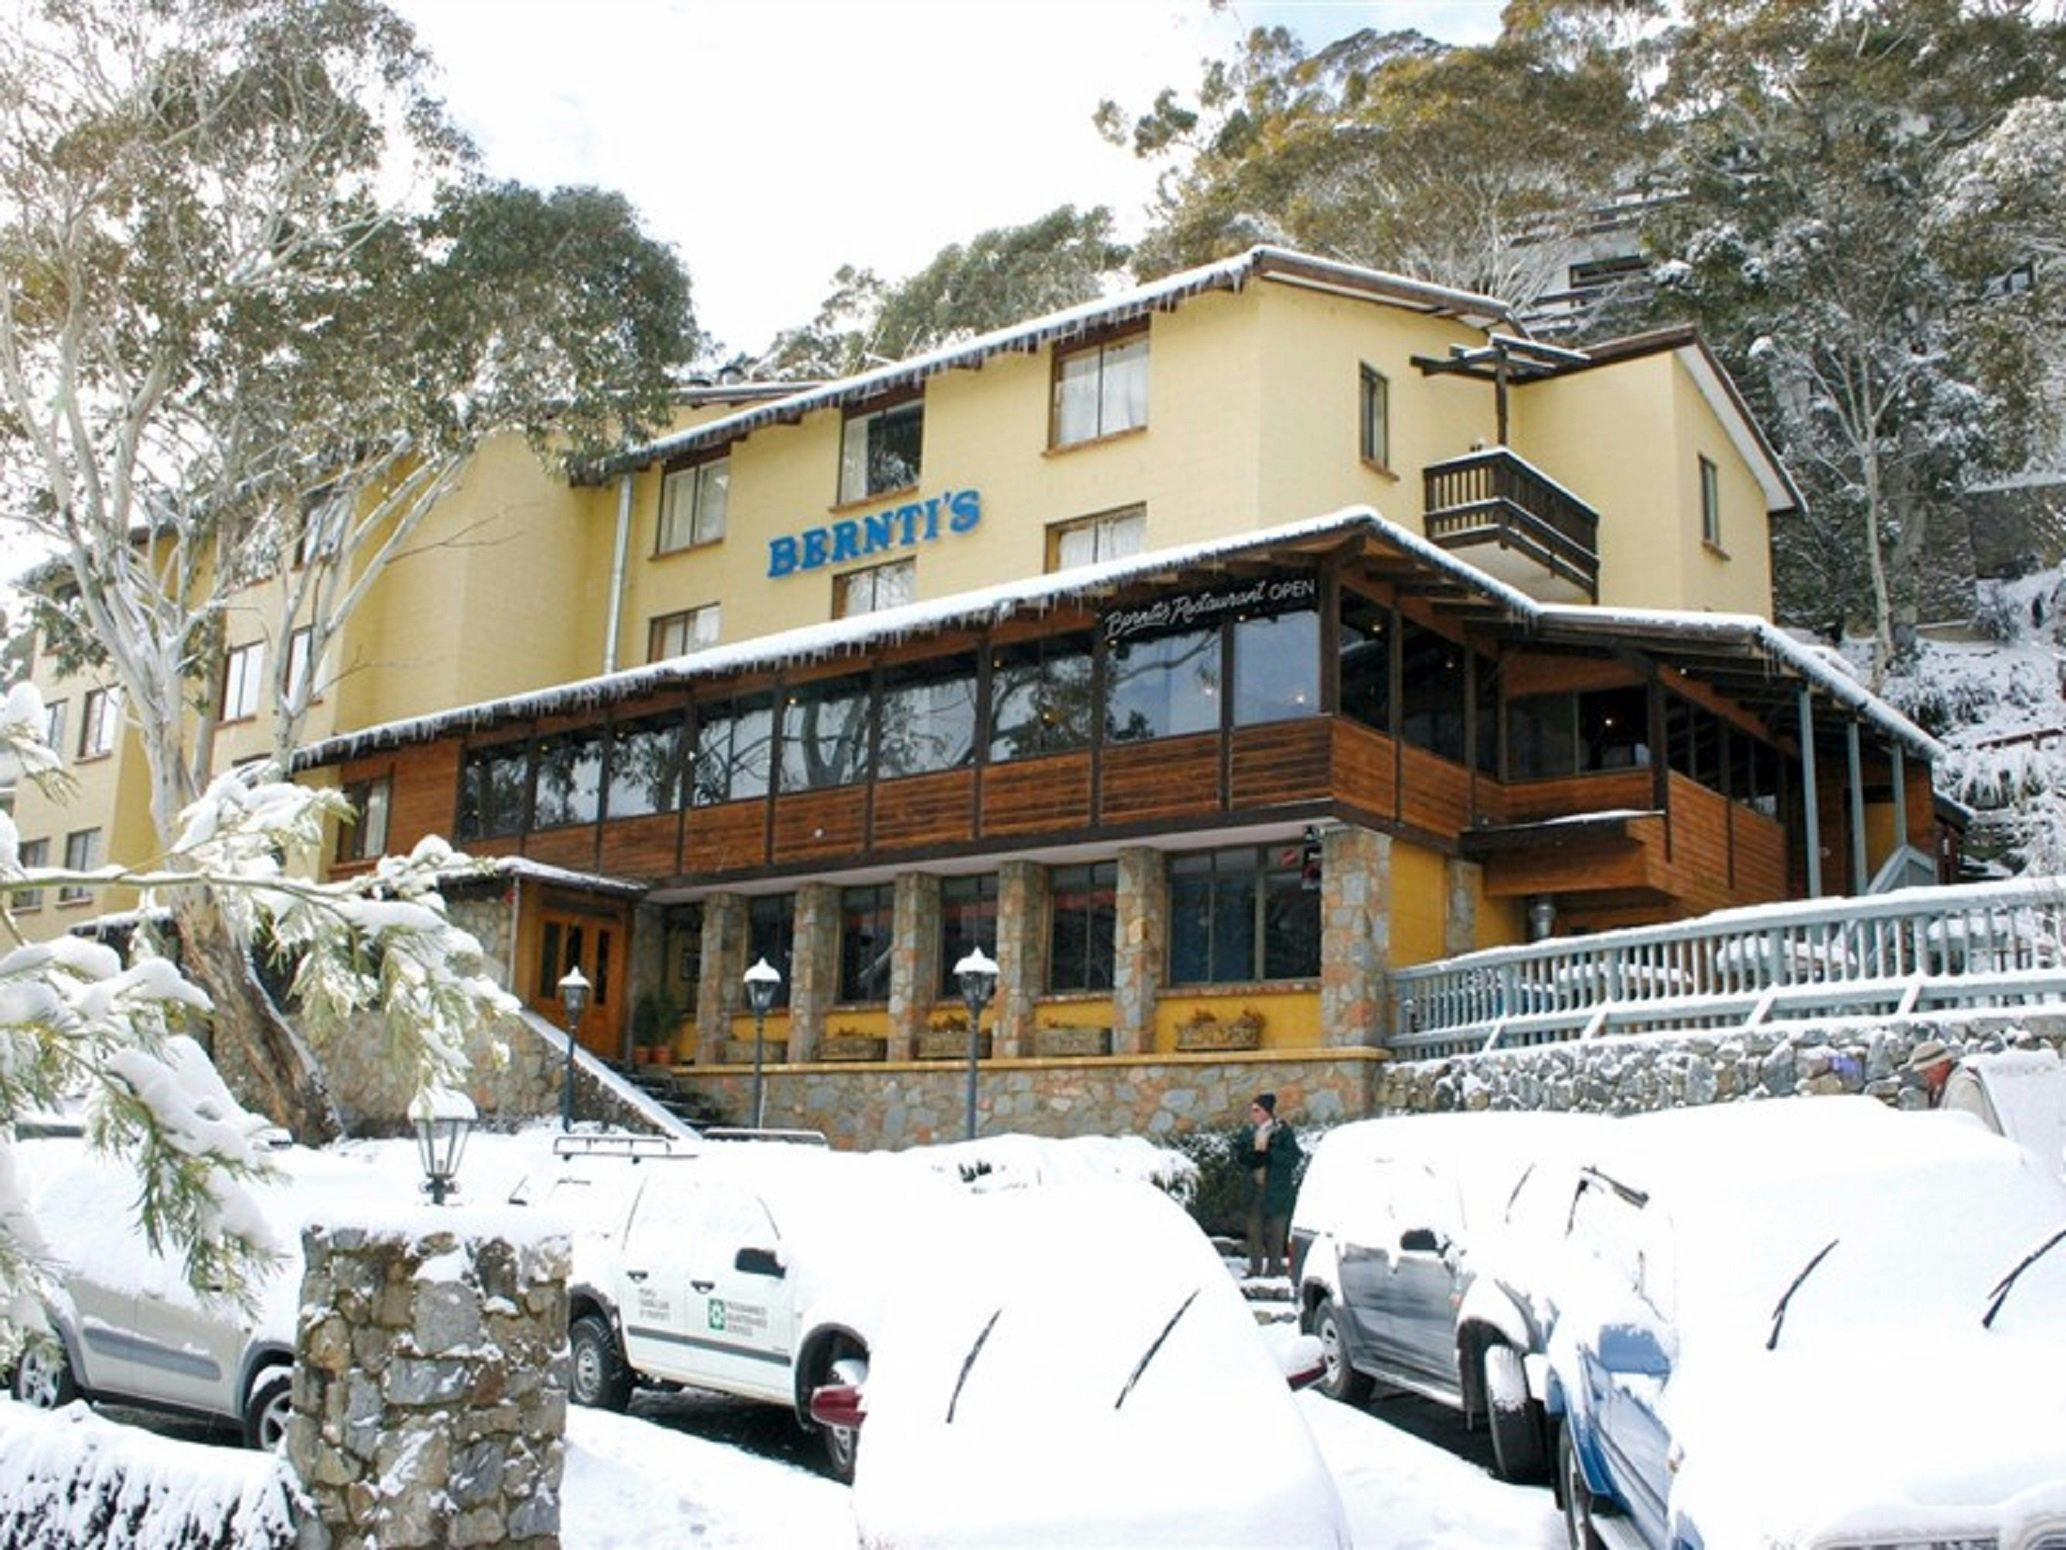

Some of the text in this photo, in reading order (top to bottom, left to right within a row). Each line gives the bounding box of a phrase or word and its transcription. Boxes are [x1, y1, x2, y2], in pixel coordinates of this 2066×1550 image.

[767, 489, 981, 578] BERNTI'S
[1171, 579, 1266, 624] Restaurant
[1269, 579, 1315, 600] OPEN
